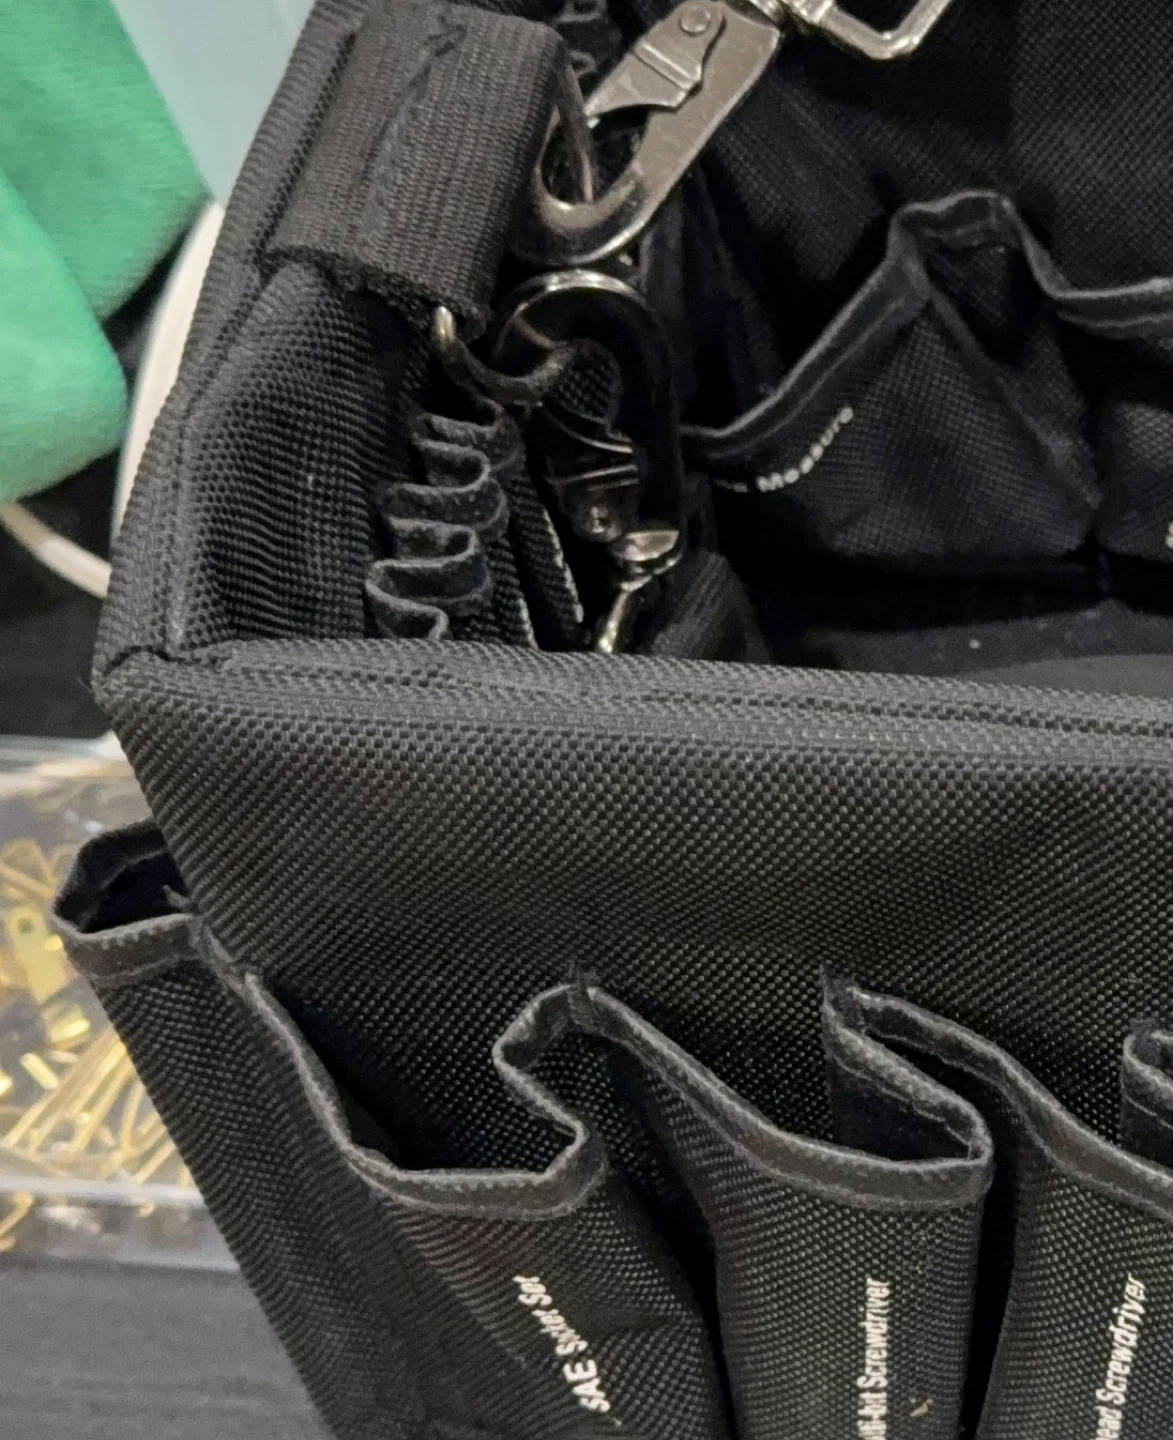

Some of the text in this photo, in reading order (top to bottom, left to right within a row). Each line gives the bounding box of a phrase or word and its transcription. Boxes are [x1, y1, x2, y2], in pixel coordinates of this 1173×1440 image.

[512, 1275, 552, 1306] Set
[856, 1277, 892, 1389] Screwdriver
[1095, 1272, 1147, 1406] Screwdriver
[563, 1359, 610, 1413] SAE
